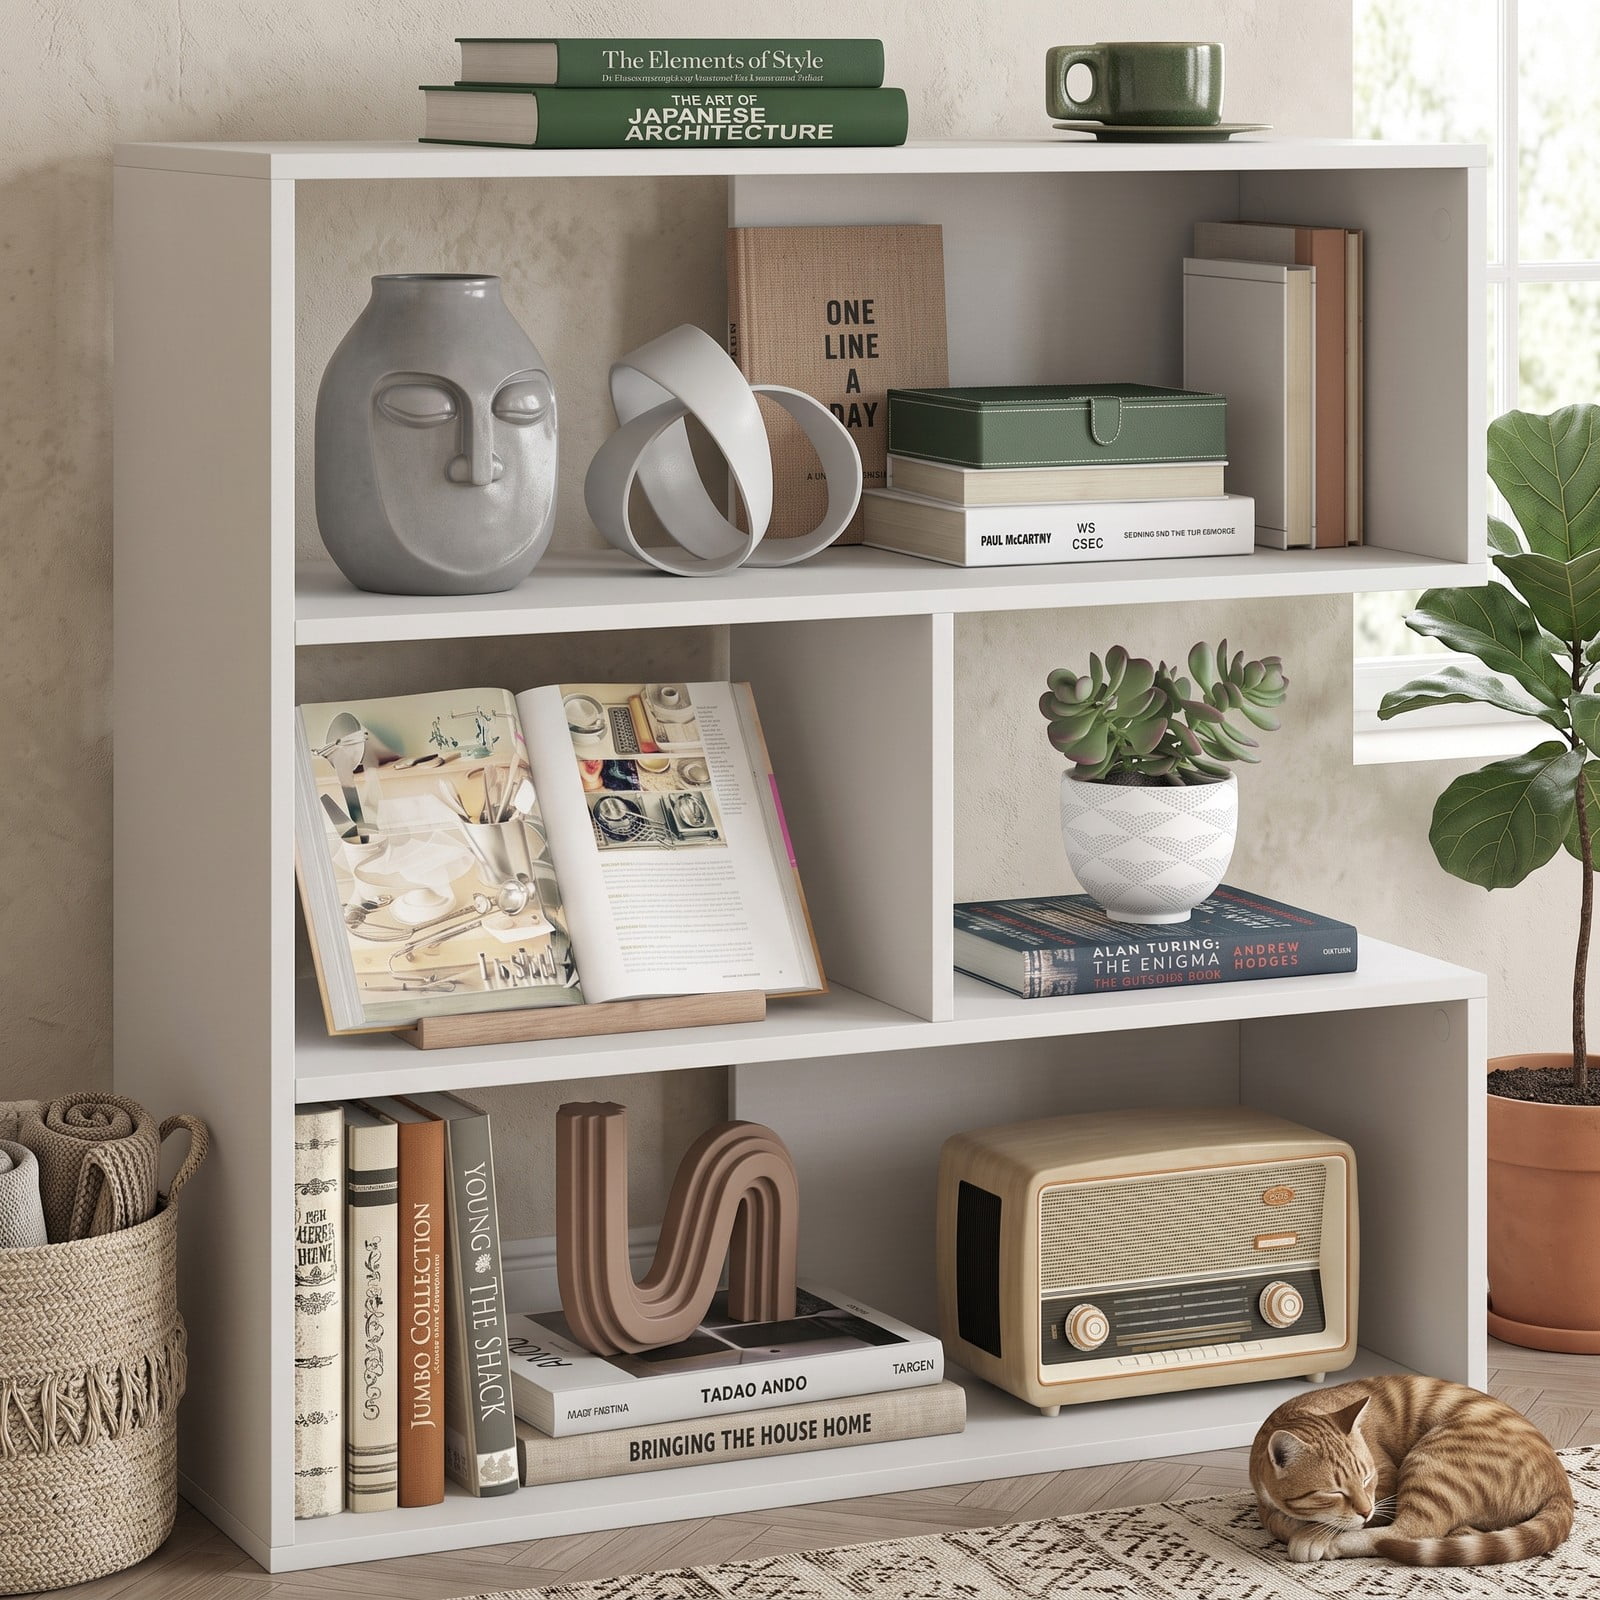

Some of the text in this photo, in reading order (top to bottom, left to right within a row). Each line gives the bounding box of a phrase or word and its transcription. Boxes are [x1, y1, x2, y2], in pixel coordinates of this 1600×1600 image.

[602, 50, 824, 73] The Elements of Style
[671, 95, 757, 106] THE ART OF
[628, 107, 766, 124] JAPANESE
[625, 124, 834, 141] ARCHITECTURE
[826, 299, 875, 326] ONE
[825, 333, 879, 360] LINE
[845, 368, 861, 394] A
[829, 402, 878, 428] DAY
[1077, 522, 1096, 534] WS
[981, 535, 1003, 546] PAUL
[1072, 538, 1104, 550] CSEC
[1093, 938, 1220, 959] ALAN TURING:
[1233, 942, 1299, 957] ANDREW
[1093, 952, 1220, 975] THE ENIGMA
[1234, 954, 1299, 969] HODGES
[1093, 977, 1117, 989] THE
[1188, 970, 1221, 981] BOOK
[464, 1161, 506, 1422] YOUNG THE SHACK
[410, 1202, 436, 1430] JUMBO COLLECTION
[892, 1358, 935, 1375] TARGEN
[701, 1375, 808, 1404] TADAO ANDO
[629, 1413, 872, 1462] BRINGING THE HOUSE HOME
